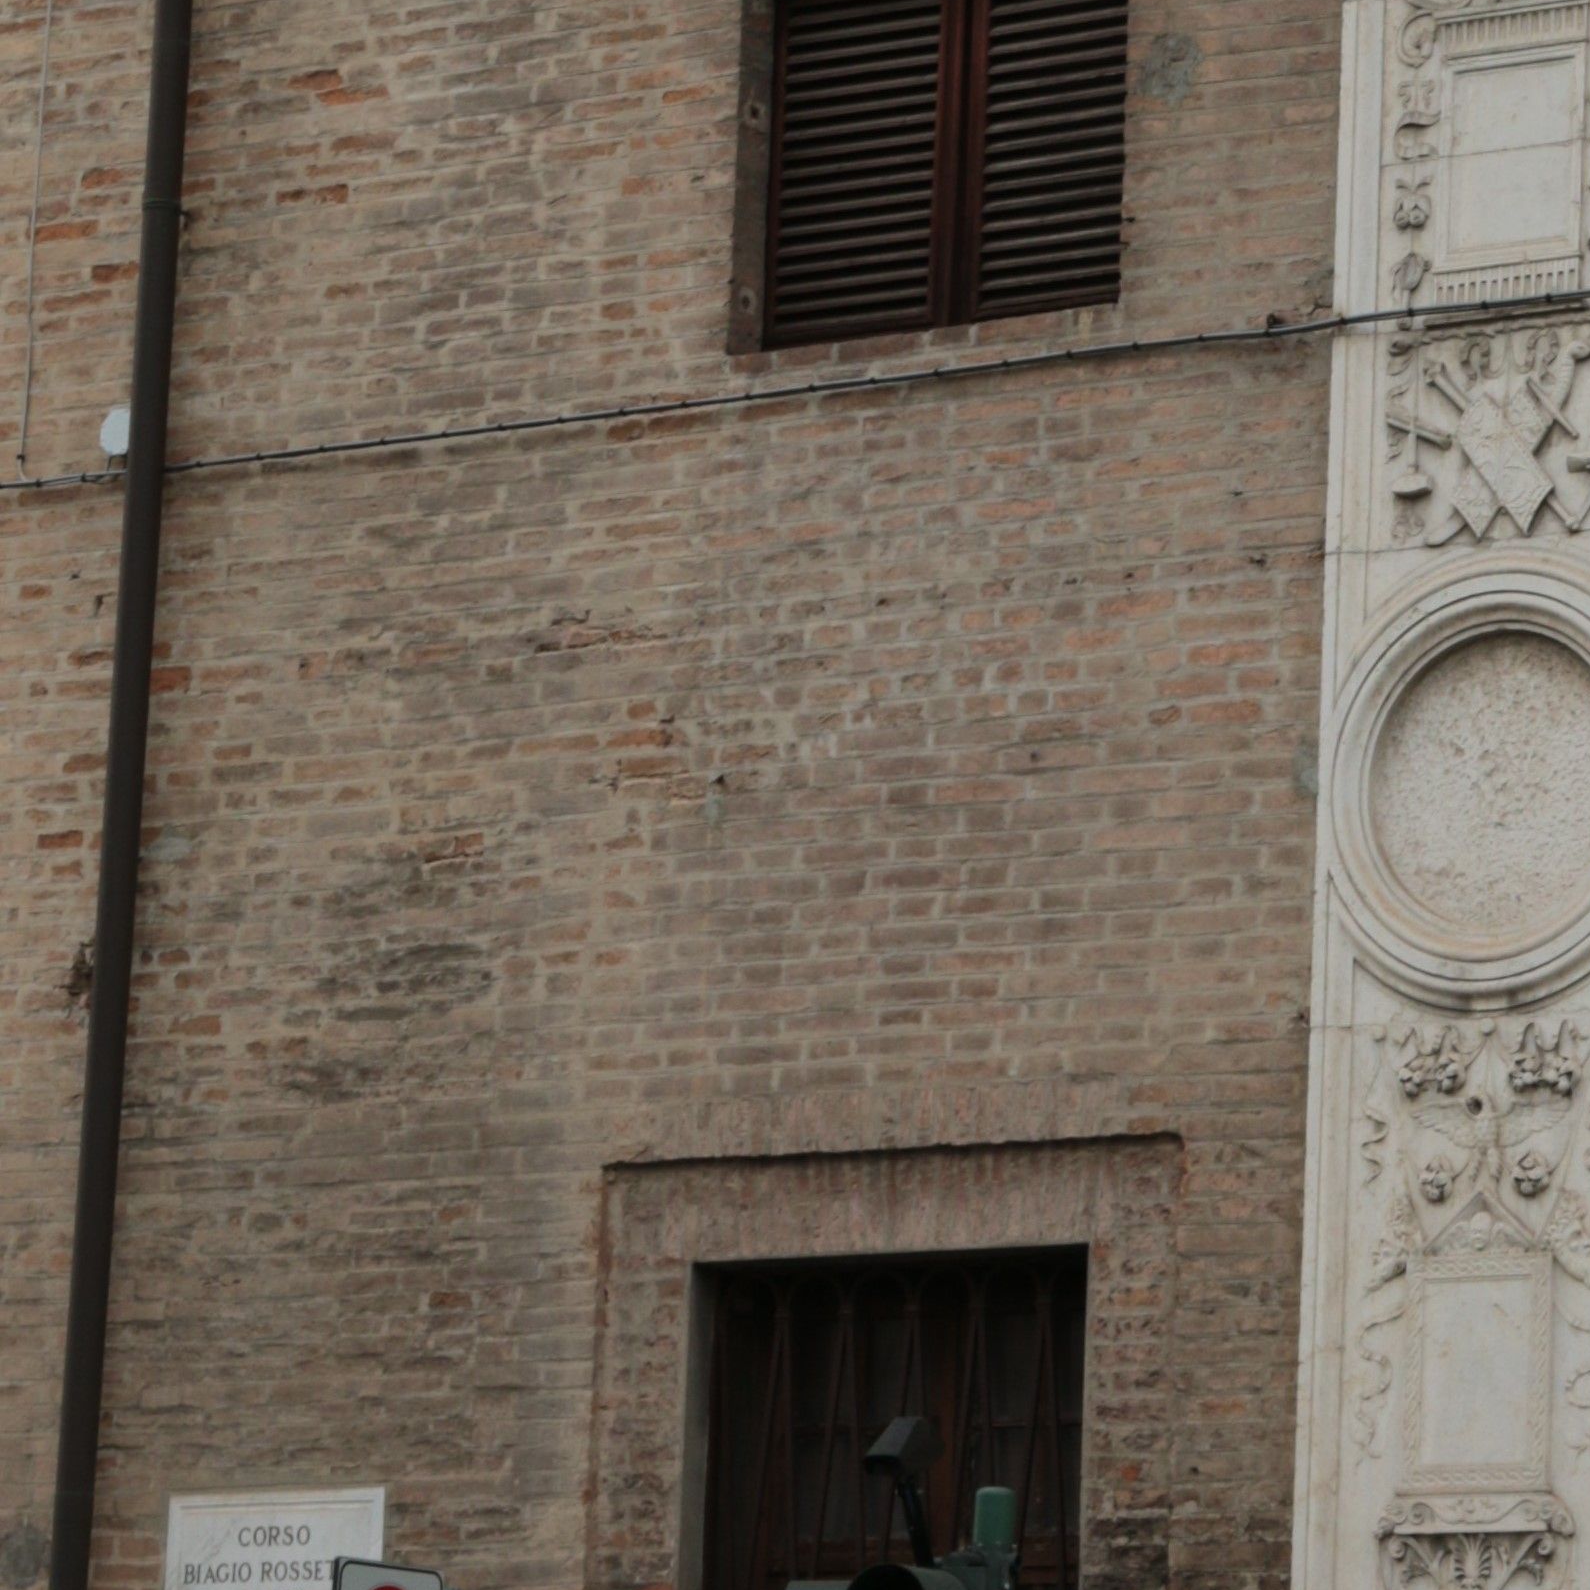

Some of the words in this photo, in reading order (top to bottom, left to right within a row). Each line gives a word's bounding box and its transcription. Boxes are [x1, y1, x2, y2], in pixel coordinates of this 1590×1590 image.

[238, 1525, 311, 1547] CORSO
[183, 1561, 252, 1585] BIAGIO
[260, 1560, 334, 1582] ROSSET
